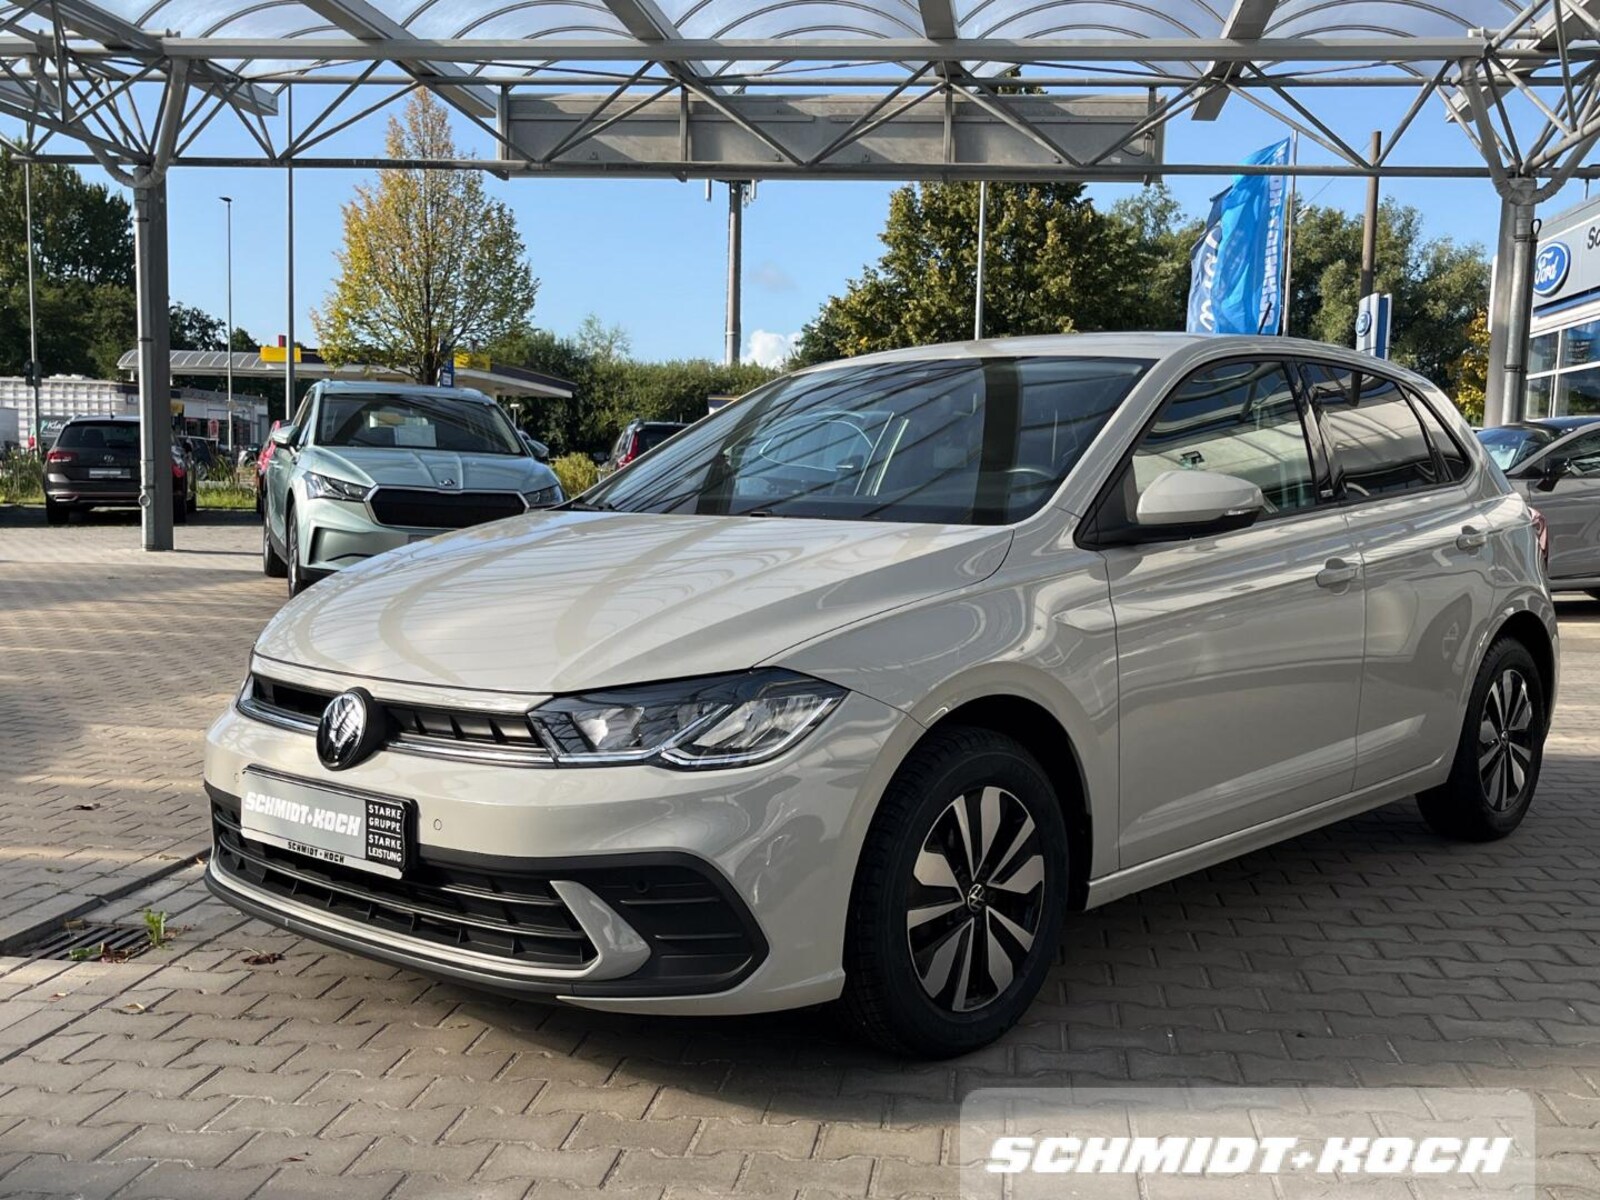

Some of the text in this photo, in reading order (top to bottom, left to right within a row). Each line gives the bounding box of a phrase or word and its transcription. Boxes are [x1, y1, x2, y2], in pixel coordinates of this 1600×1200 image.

[1534, 251, 1559, 285] Ford
[368, 804, 402, 820] STARKE
[368, 817, 401, 832] GRUPPE
[368, 834, 402, 850] STARKE
[368, 846, 402, 863] LEISTUNG
